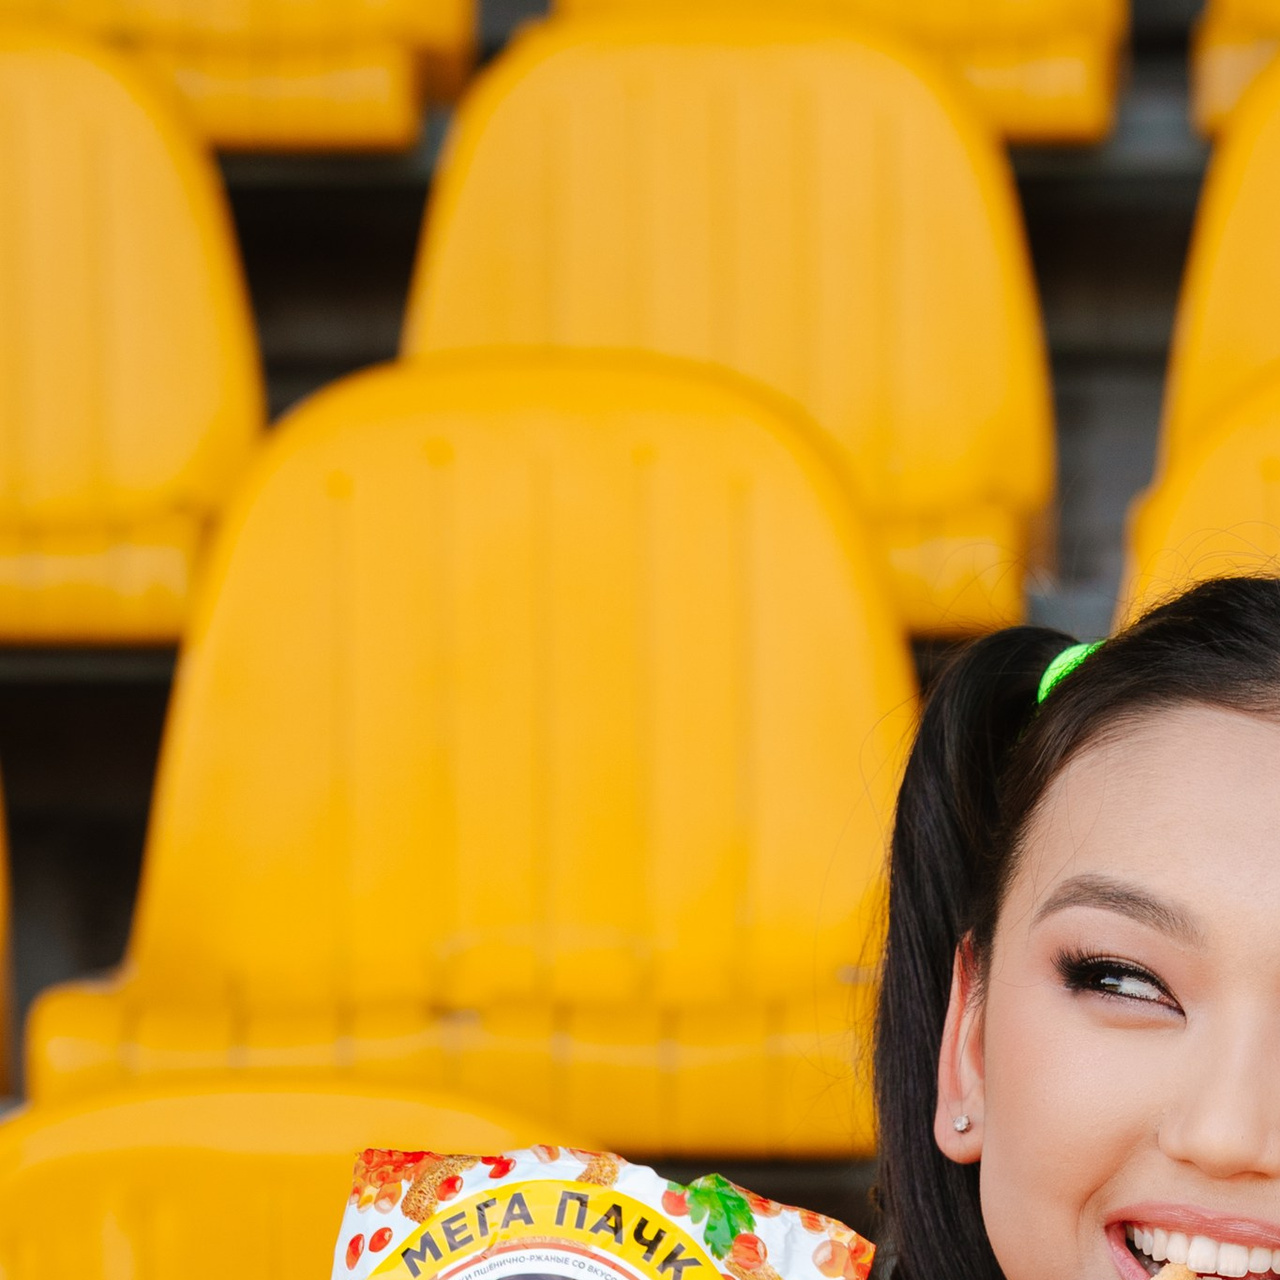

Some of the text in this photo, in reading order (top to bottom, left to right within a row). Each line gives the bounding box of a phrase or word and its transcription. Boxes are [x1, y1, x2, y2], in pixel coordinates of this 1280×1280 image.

[401, 1192, 534, 1278] МЕГА
[473, 1253, 570, 1278] ПШЕНИЧНО-РЖАНЫЕ
[572, 1259, 586, 1270] СО
